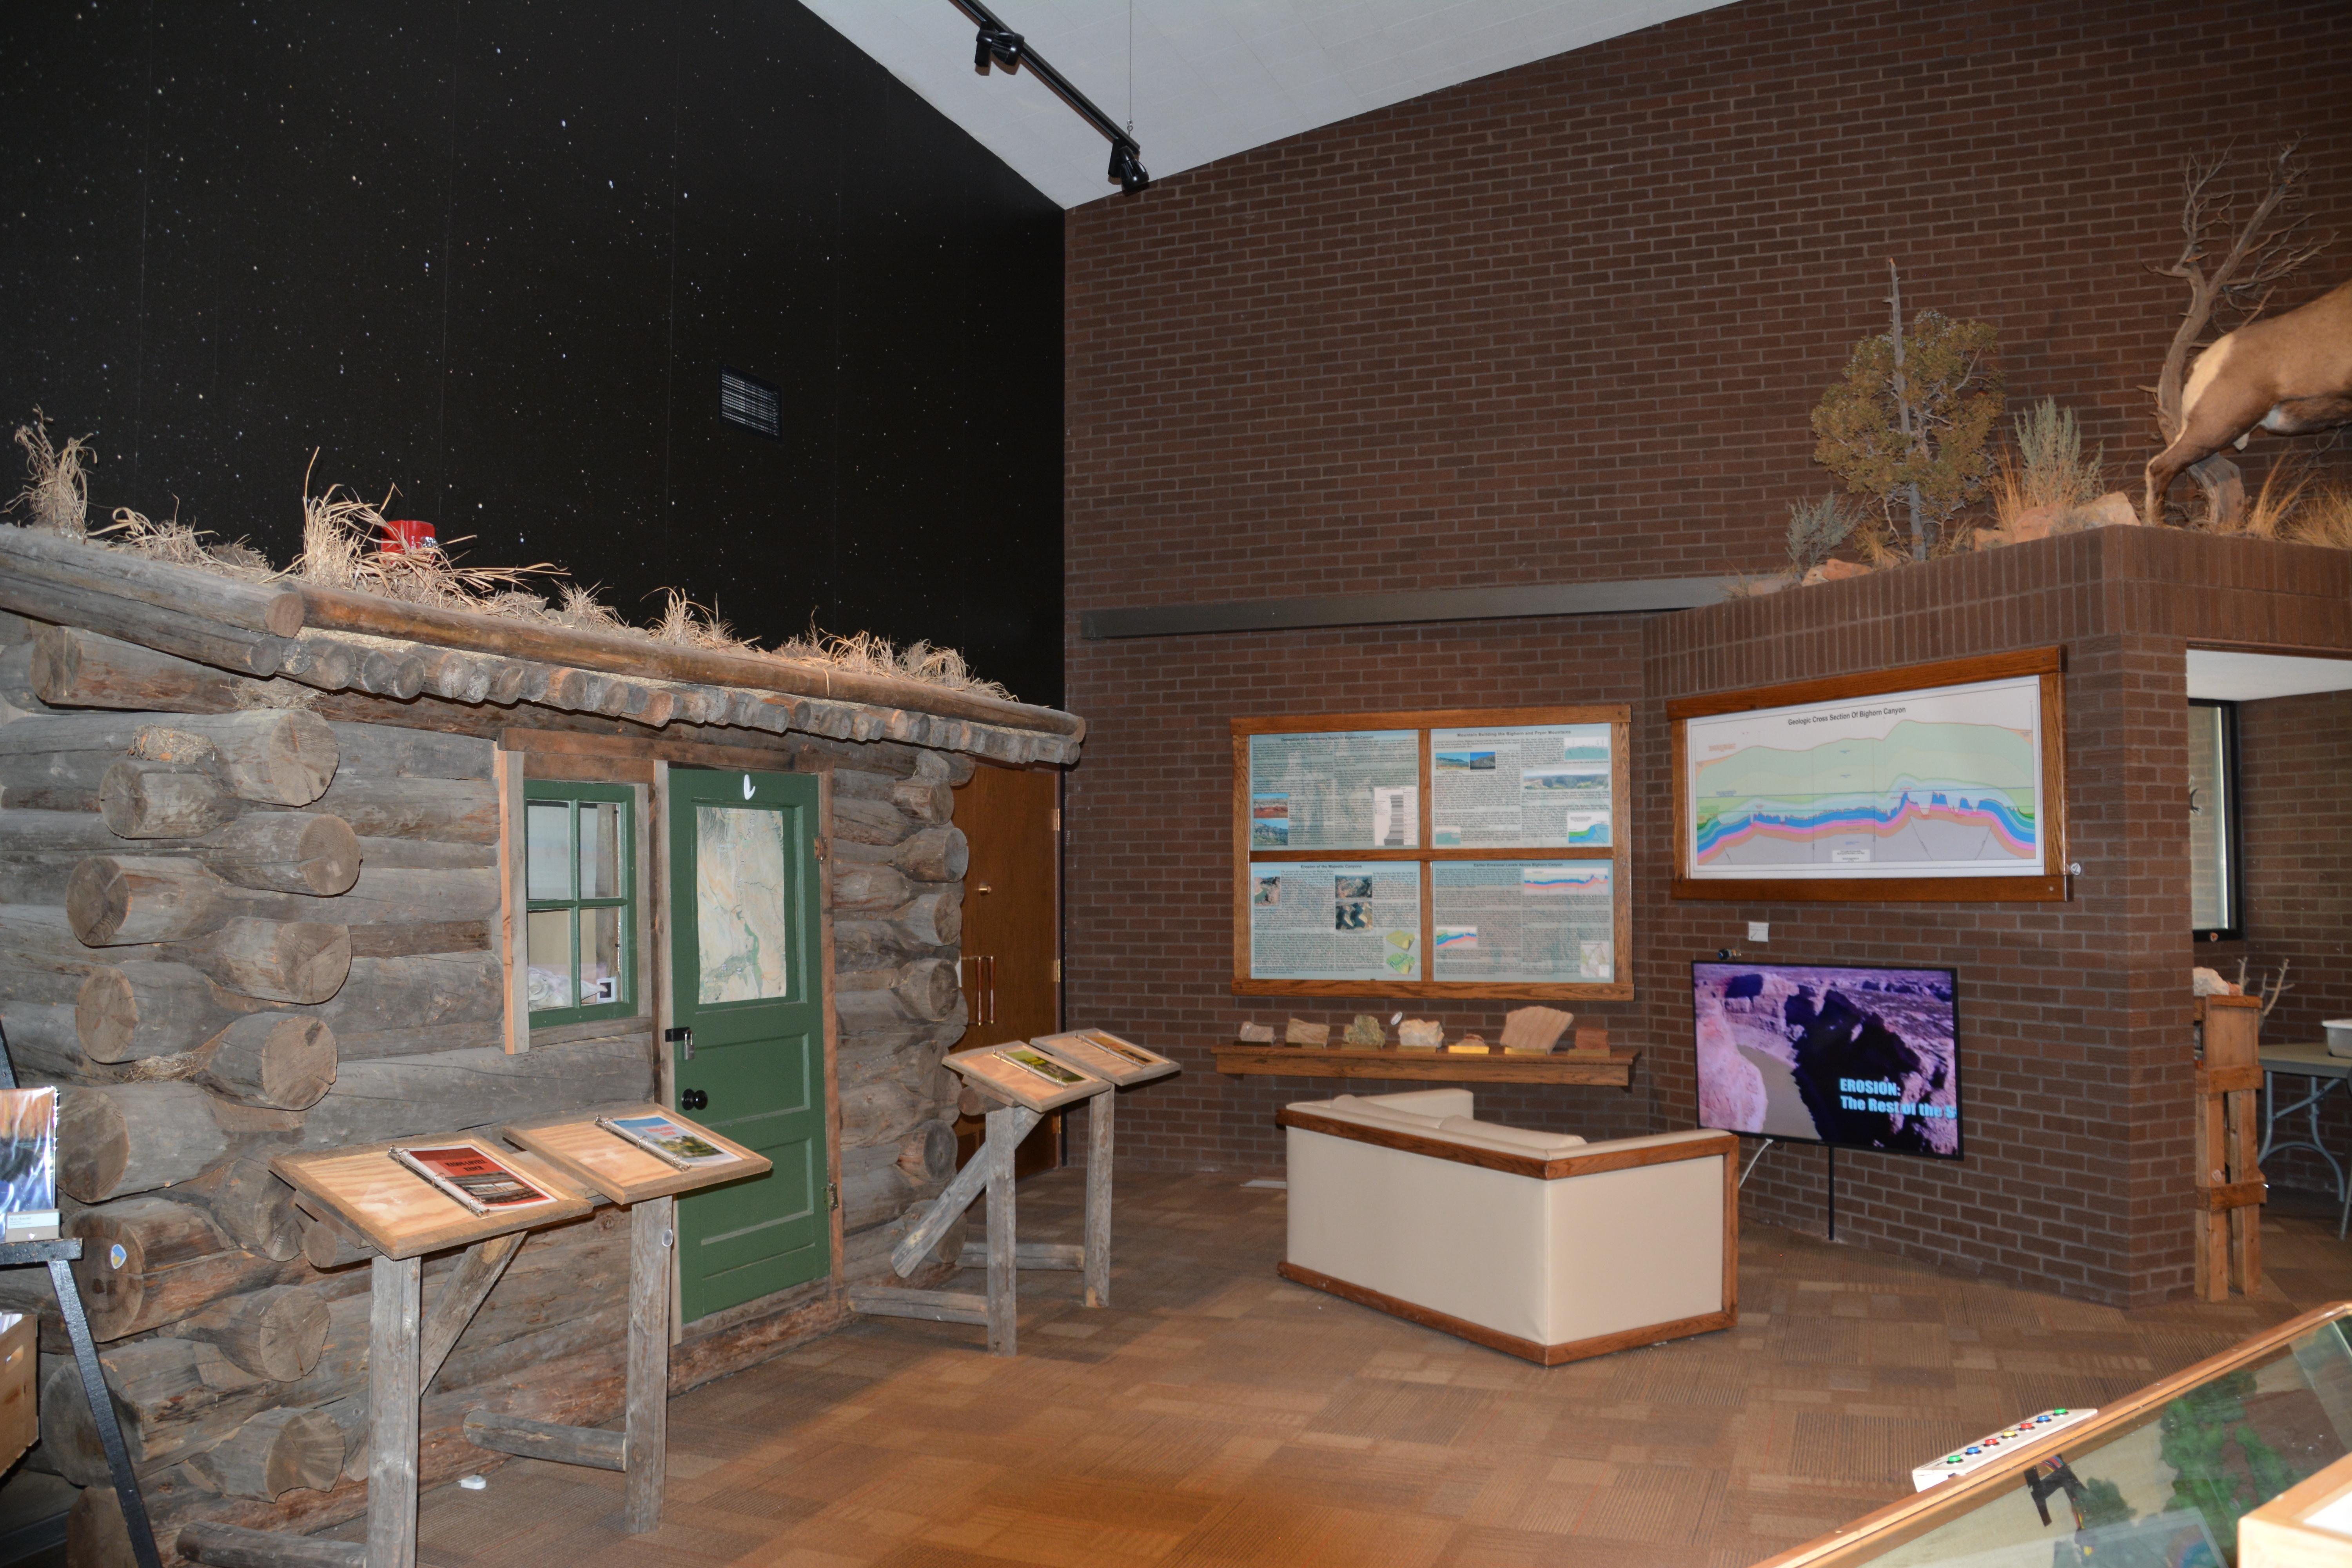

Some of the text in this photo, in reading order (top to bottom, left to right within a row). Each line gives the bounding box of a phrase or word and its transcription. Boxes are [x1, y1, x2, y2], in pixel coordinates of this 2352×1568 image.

[1788, 717, 1811, 726] Geologic
[1859, 709, 1882, 719] Bighorn
[1883, 707, 1906, 715] Canyon
[1840, 1078, 1901, 1096] EROSION:
[1840, 1095, 1866, 1111] The
[1868, 1097, 1900, 1113] Rest
[1901, 1102, 1917, 1116] of
[1918, 1103, 1943, 1118] the
